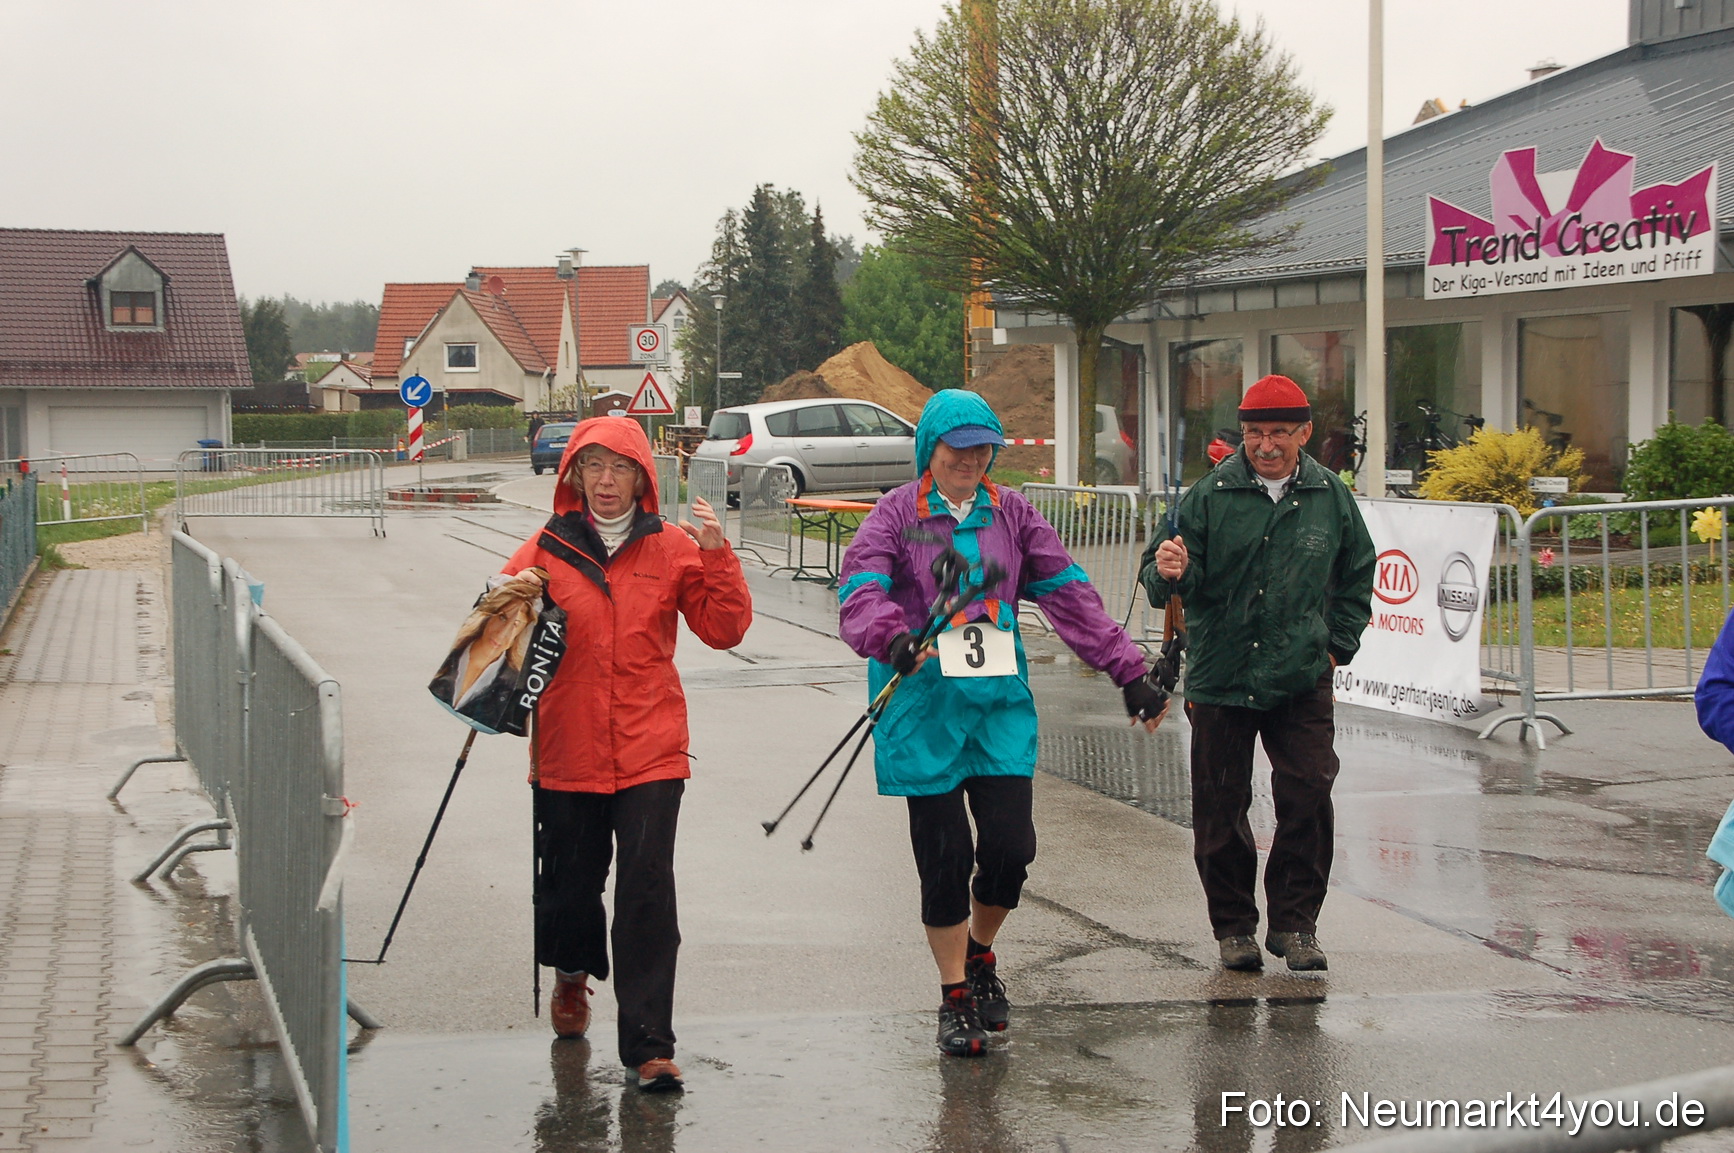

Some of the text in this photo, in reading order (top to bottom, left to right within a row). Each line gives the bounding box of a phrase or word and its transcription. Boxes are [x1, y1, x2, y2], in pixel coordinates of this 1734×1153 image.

[1441, 200, 1697, 267] Trend Creativ
[1432, 249, 1702, 294] Der Kiga-Versand mit Ideen und Pfiff
[641, 335, 655, 346] 30
[1379, 562, 1411, 592] KIA
[1441, 588, 1475, 606] NISSAN
[1378, 613, 1424, 635] MOTORS
[963, 626, 985, 668] 3
